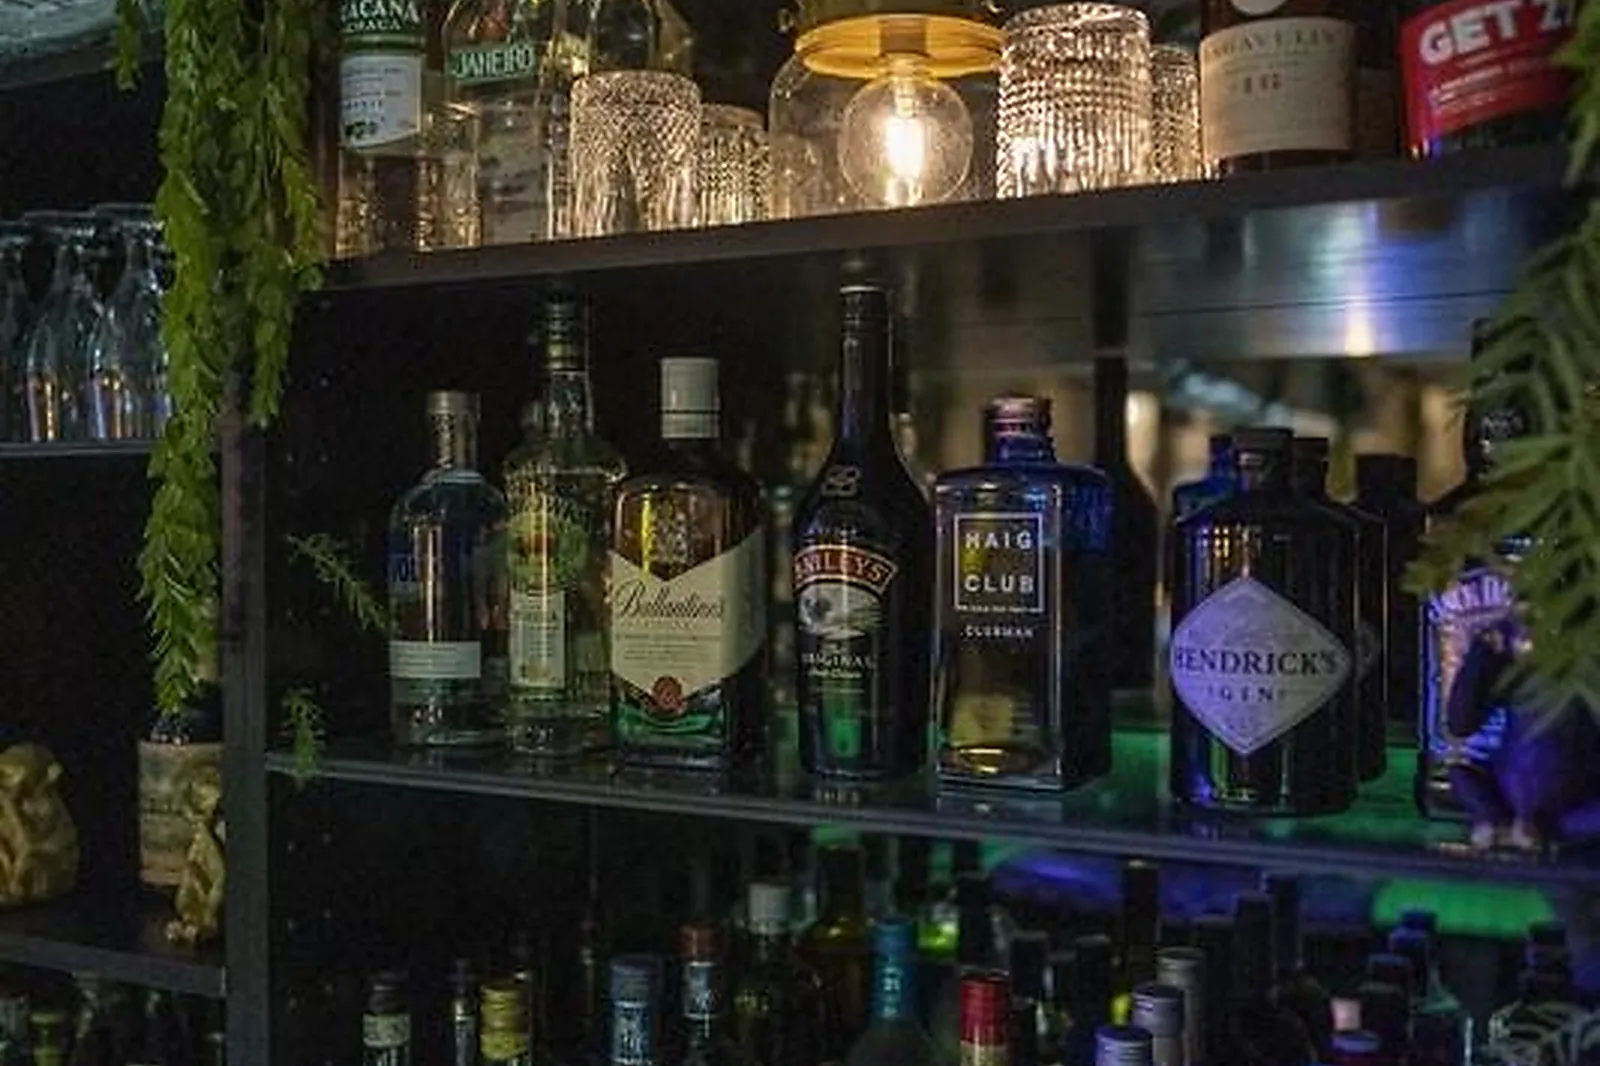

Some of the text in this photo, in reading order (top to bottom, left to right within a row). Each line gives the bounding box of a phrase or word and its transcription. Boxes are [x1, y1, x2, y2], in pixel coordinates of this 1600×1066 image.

[1419, 0, 1520, 65] GET
[452, 44, 537, 79] JANEIRO
[964, 530, 1032, 550] HAIG
[964, 573, 1034, 594] CLUB
[1174, 648, 1340, 675] HENDRICK'S
[1219, 685, 1274, 701] GIN
